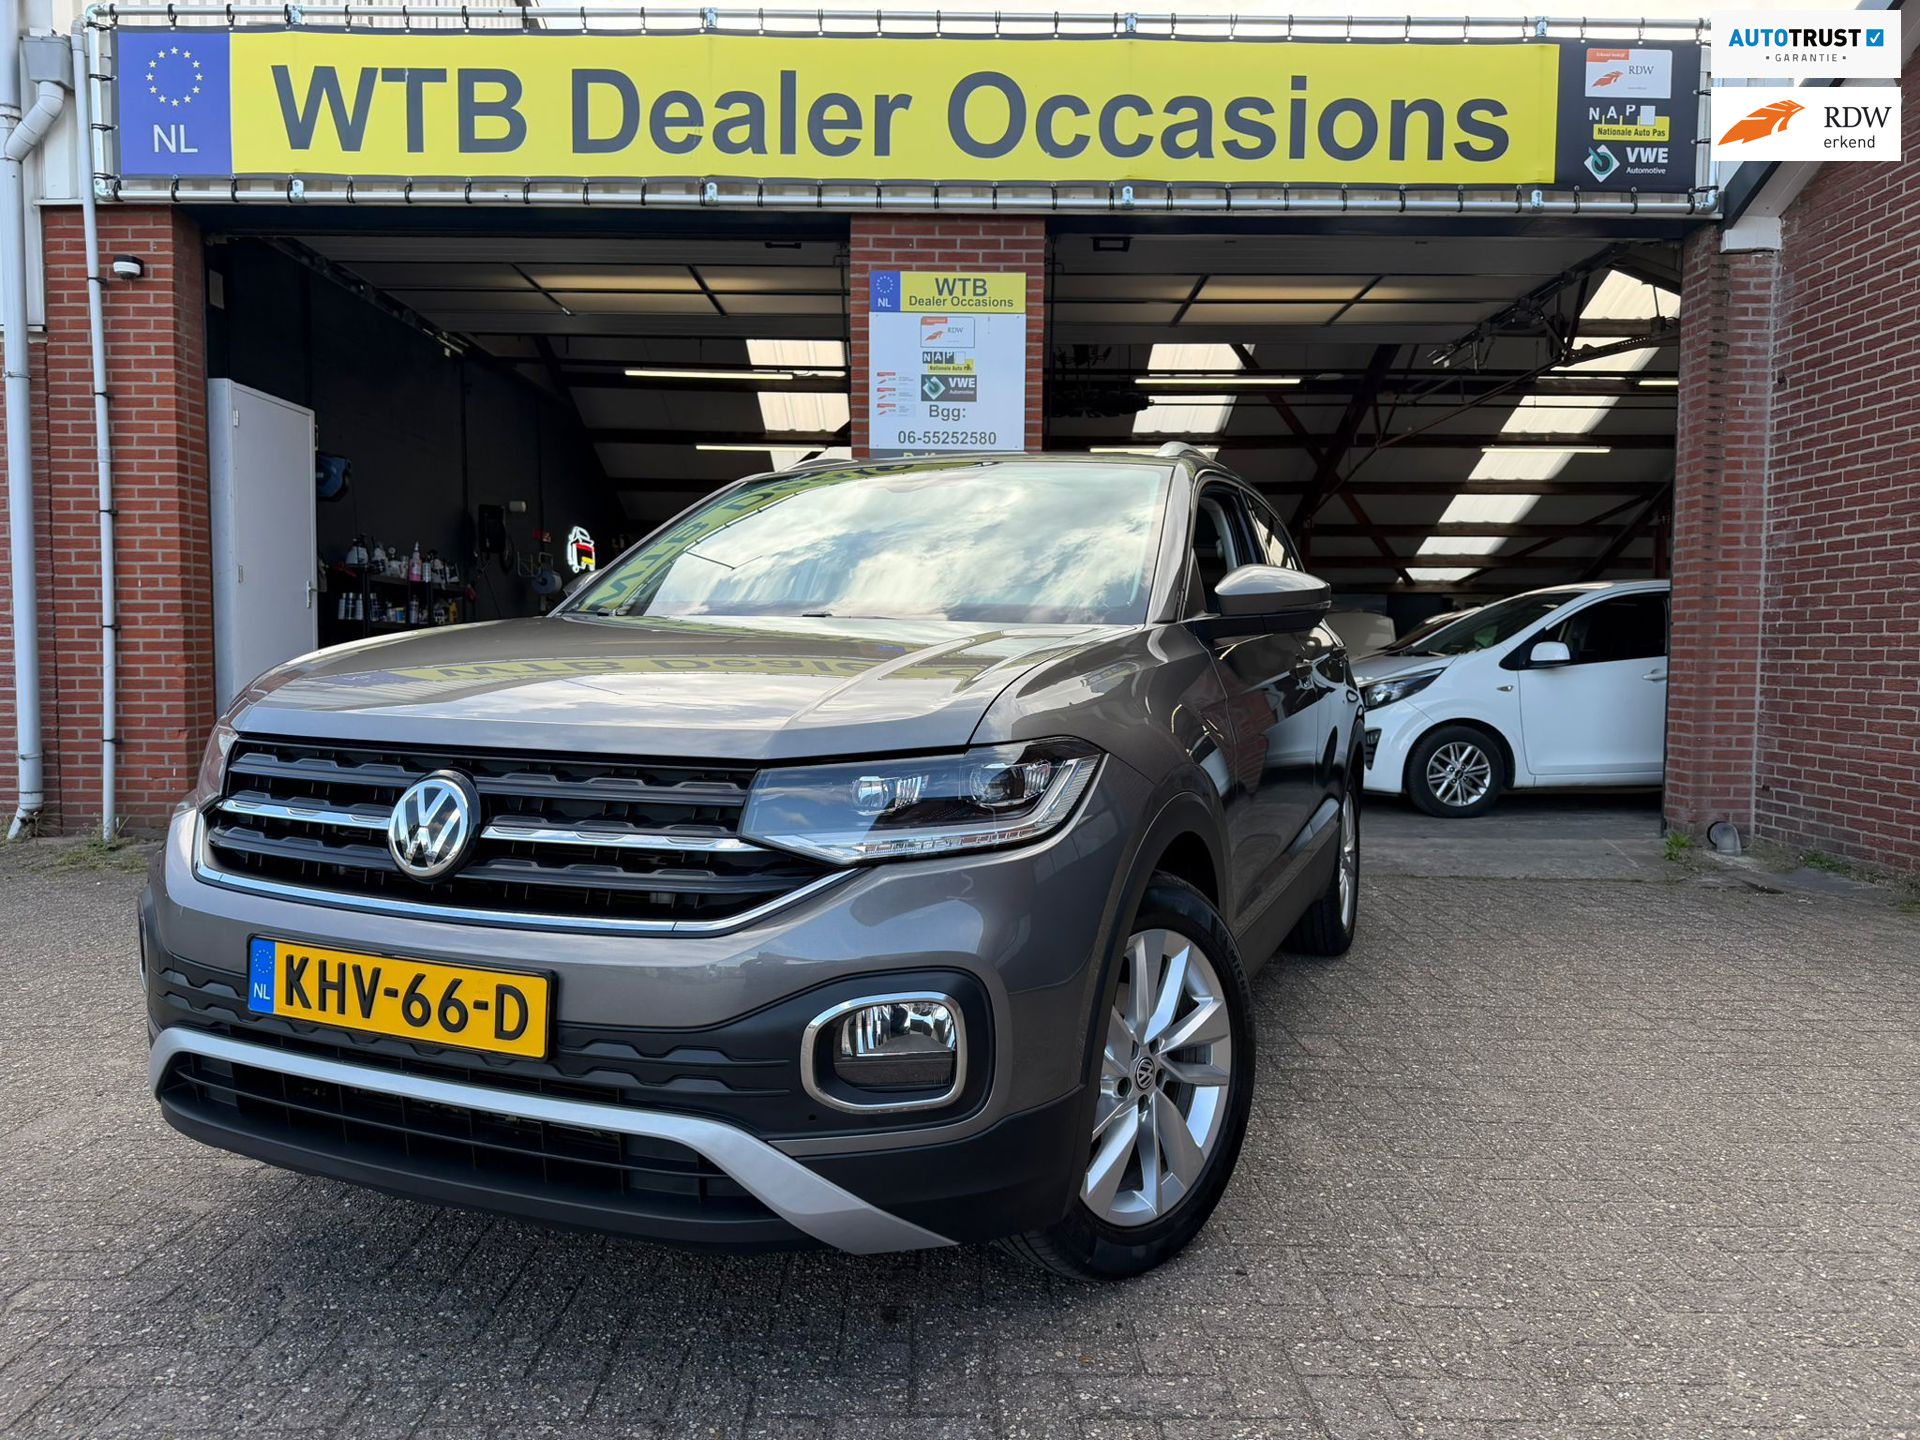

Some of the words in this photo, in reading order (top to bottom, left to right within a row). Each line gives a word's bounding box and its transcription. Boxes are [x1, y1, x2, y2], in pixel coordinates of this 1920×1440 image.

[1628, 65, 1654, 75] RDW
[270, 64, 528, 154] WTB
[571, 67, 913, 158] Dealer
[947, 70, 1510, 162] Occasions
[153, 123, 198, 154] NL
[1597, 127, 1632, 138] Nationale
[1634, 127, 1650, 138] Auto
[1651, 127, 1666, 138] Pas
[1626, 147, 1668, 163] VWE
[1625, 166, 1666, 175] Automotive
[935, 278, 988, 297] WTB
[877, 298, 892, 308] NL
[908, 295, 947, 307] Dealer
[950, 296, 1014, 308] Occasions
[948, 377, 976, 388] VWE
[929, 404, 966, 421] Bgg:
[898, 430, 997, 446] 06-55252580
[253, 981, 271, 1001] NL
[284, 953, 529, 1042] KHV-66-D
